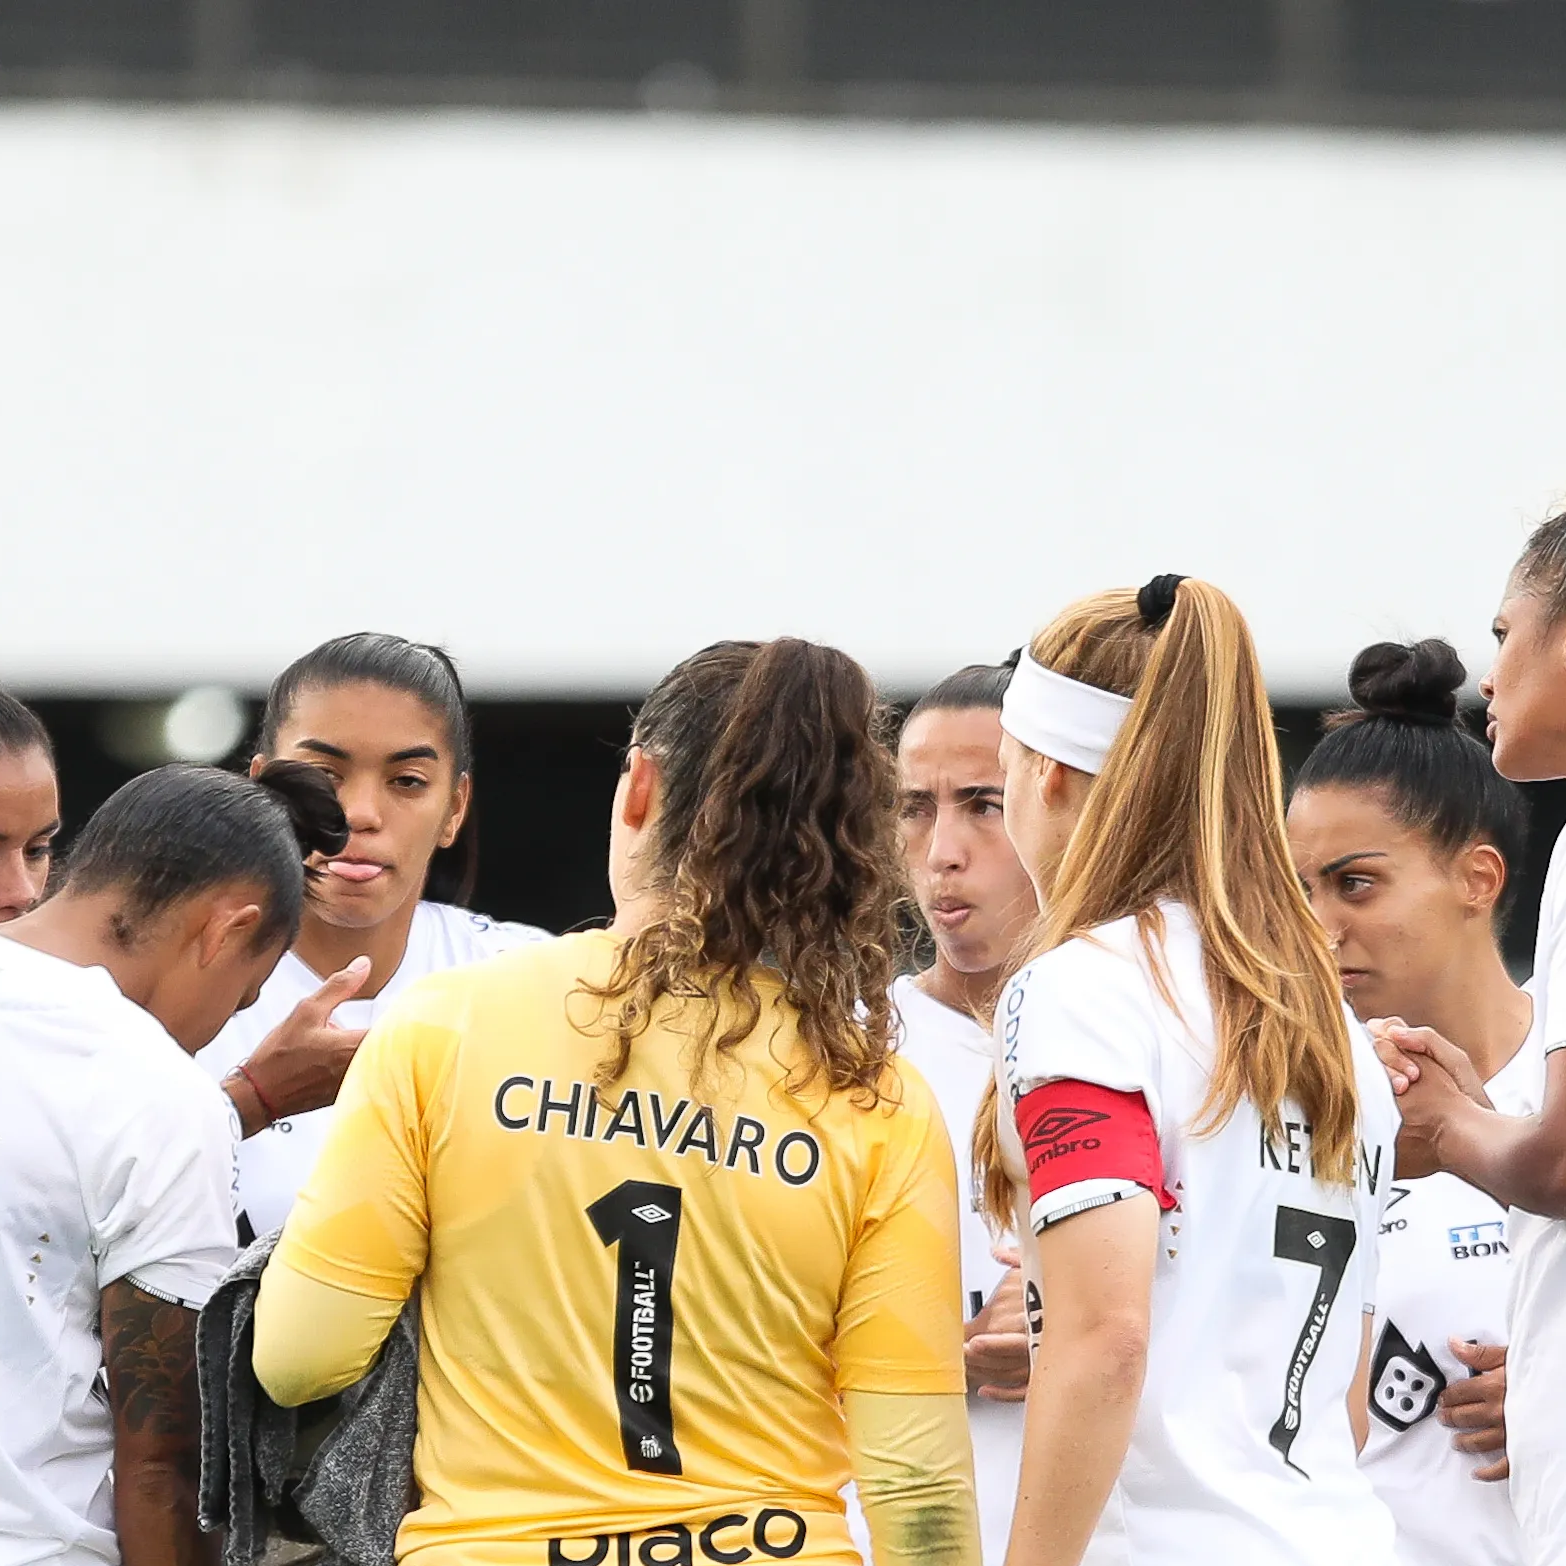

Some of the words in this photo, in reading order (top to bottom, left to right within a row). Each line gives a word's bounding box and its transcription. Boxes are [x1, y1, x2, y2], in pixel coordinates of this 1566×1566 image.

[493, 1075, 821, 1187] CHIAVARO
[584, 1179, 683, 1476] 1
[1269, 1205, 1358, 1480] 7
